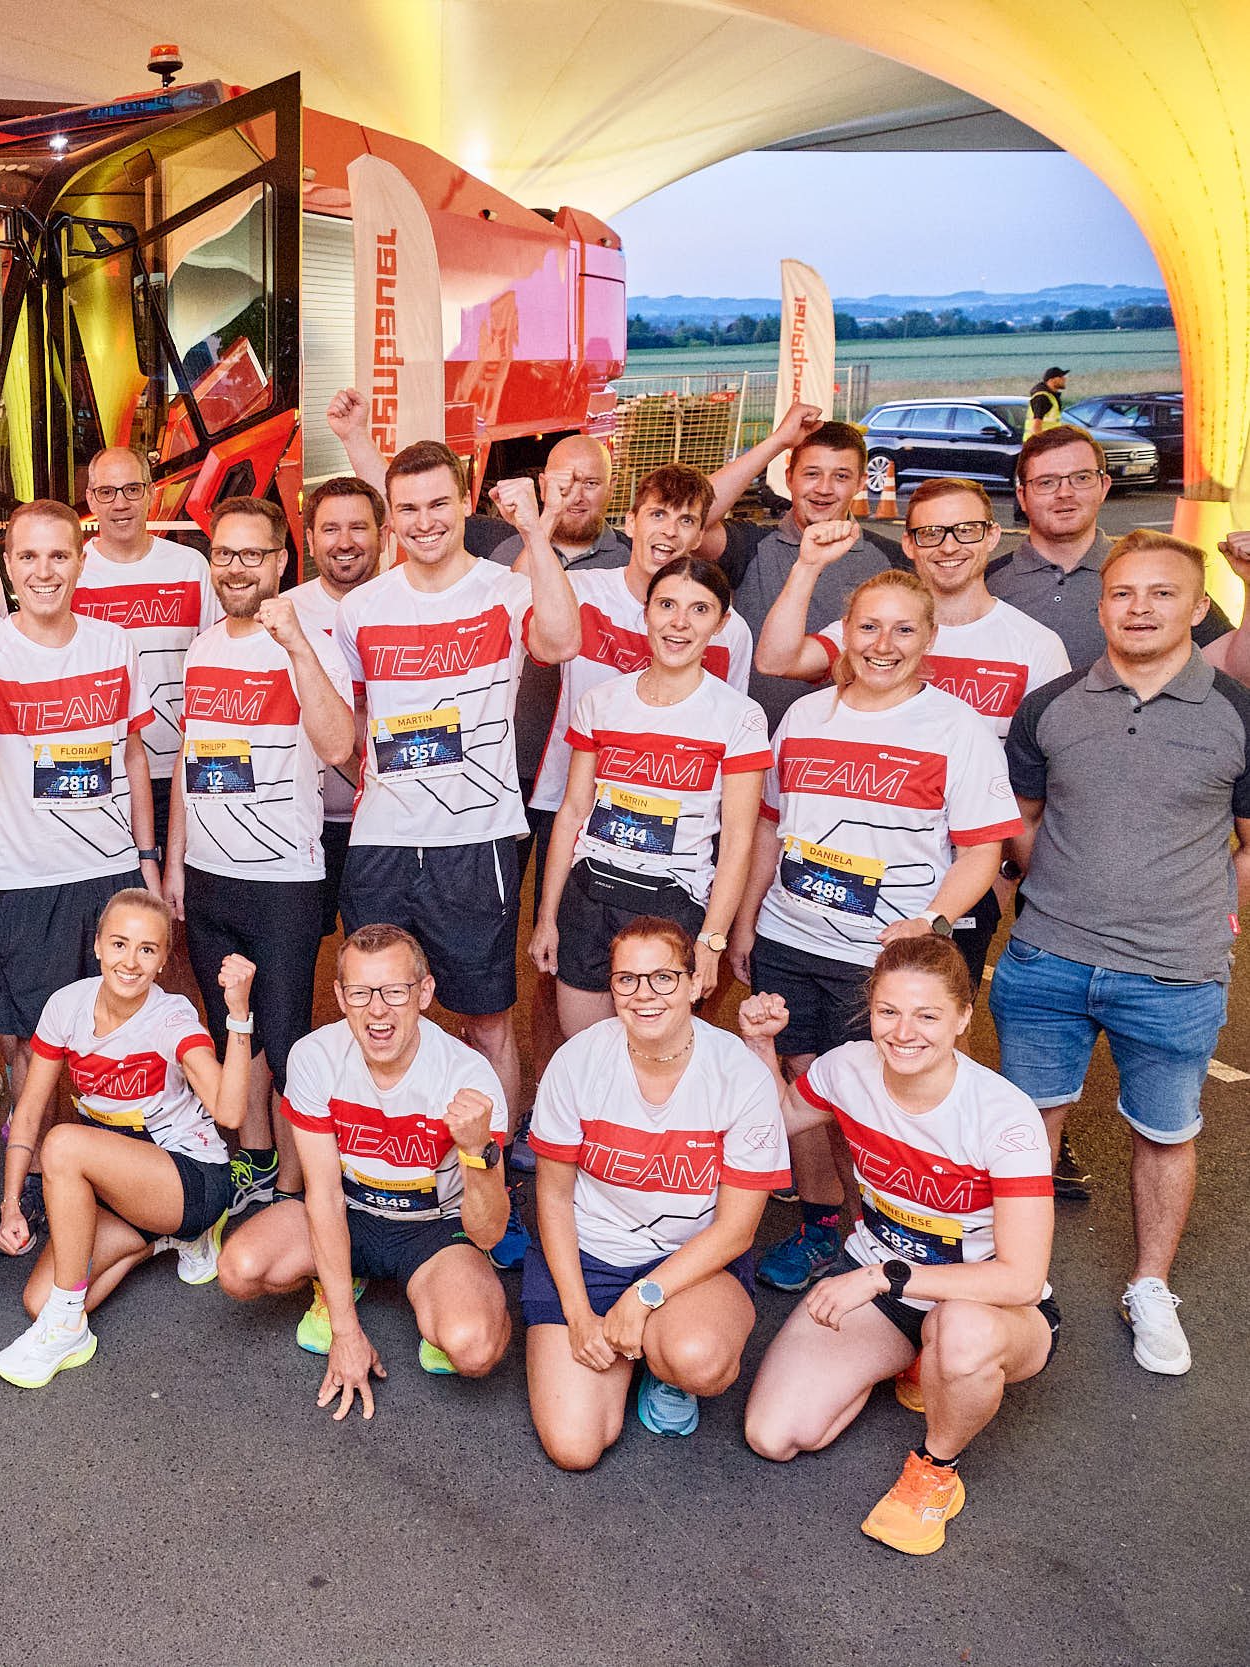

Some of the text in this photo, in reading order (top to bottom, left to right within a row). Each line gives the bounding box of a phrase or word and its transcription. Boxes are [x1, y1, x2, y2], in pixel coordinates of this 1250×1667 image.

[79, 598, 182, 626] TEAM
[368, 634, 485, 676] TEAM
[9, 688, 120, 731] TEAM
[398, 714, 433, 726] MARTIN
[60, 746, 99, 755] FLORIAN
[400, 742, 439, 762] 1957
[58, 775, 98, 791] 2818
[207, 770, 224, 786] 12
[782, 757, 909, 800] TEAM
[619, 793, 648, 808] KATRIN
[609, 820, 647, 844] 1344
[809, 847, 853, 866] DANIELA
[801, 875, 847, 902] 2488
[583, 1141, 721, 1190] TEAM
[847, 1140, 973, 1210] TEAM
[364, 1192, 411, 1208] 2848
[876, 1198, 932, 1228] ANNELIESE
[880, 1225, 928, 1258] 2825
